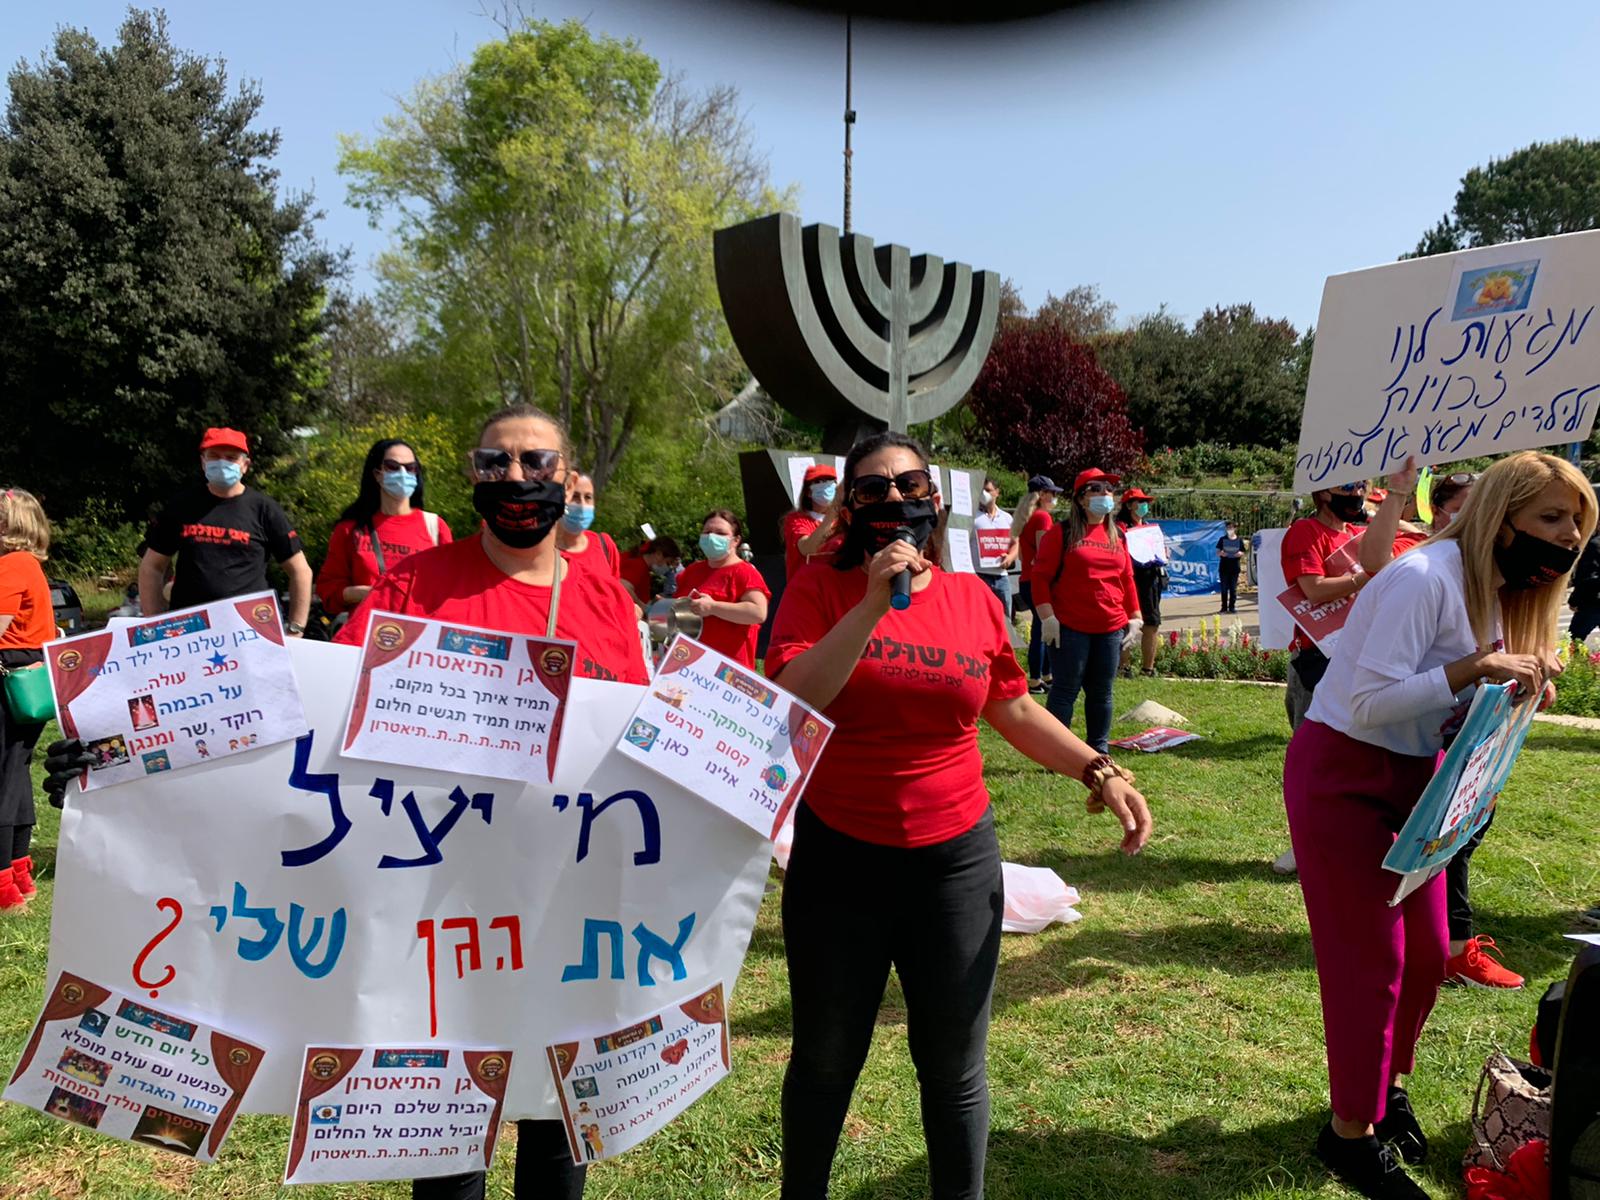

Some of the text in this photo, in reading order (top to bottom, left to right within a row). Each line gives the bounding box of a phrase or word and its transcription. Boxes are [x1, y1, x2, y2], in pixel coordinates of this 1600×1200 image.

[1382, 306, 1594, 391] מגיעות לנו
[1421, 413, 1487, 454] מגיע
[1380, 424, 1410, 471] גן
[187, 634, 225, 655] שלנו
[232, 628, 259, 647] בגן
[126, 651, 153, 668] ילד
[159, 644, 180, 660] כל
[860, 636, 988, 681] אני שולמ
[407, 650, 534, 686] גן התיאטרון
[678, 666, 720, 692] יוצאים
[133, 671, 186, 694] עולה...
[439, 682, 467, 700] בכל
[158, 684, 242, 715] על הבמה
[473, 689, 508, 706] איתך
[514, 695, 550, 712] תמיד
[722, 689, 741, 705] יום
[745, 699, 760, 717] כל
[220, 709, 264, 731] רוקד
[375, 698, 547, 735] איתו תמיד תגשים חלום
[665, 711, 704, 740] מרגש
[128, 730, 175, 756] ומנגן
[529, 743, 542, 757] גן
[715, 740, 751, 767] קסום
[705, 761, 739, 788] אלינו
[280, 729, 661, 869] מי יציל
[749, 788, 778, 814] נגלה
[132, 880, 696, 1038] את הגן שלי ?
[115, 1024, 210, 1067] כל יום חדש
[693, 1028, 716, 1047] מכל
[60, 1027, 228, 1097] נפגשנו עם עולם מופלא
[617, 1041, 657, 1065] רקדנו
[574, 1062, 613, 1077] ושרנו
[616, 1062, 660, 1089] ונשמה
[703, 1061, 719, 1077] את
[42, 1067, 99, 1100] המחזות
[118, 1074, 218, 1115] מתוך האגדות
[345, 1076, 472, 1094] גן התיאטרון
[680, 1075, 701, 1096] אמא
[104, 1093, 141, 1114] נולדו
[346, 1100, 487, 1114] הבית שלכם היום
[595, 1095, 640, 1119] ריגשנו
[657, 1094, 677, 1111] ואת
[630, 1108, 654, 1126] אבא
[314, 1124, 483, 1139] יוביל אתכם אל החלום
[467, 1143, 479, 1156] גן
